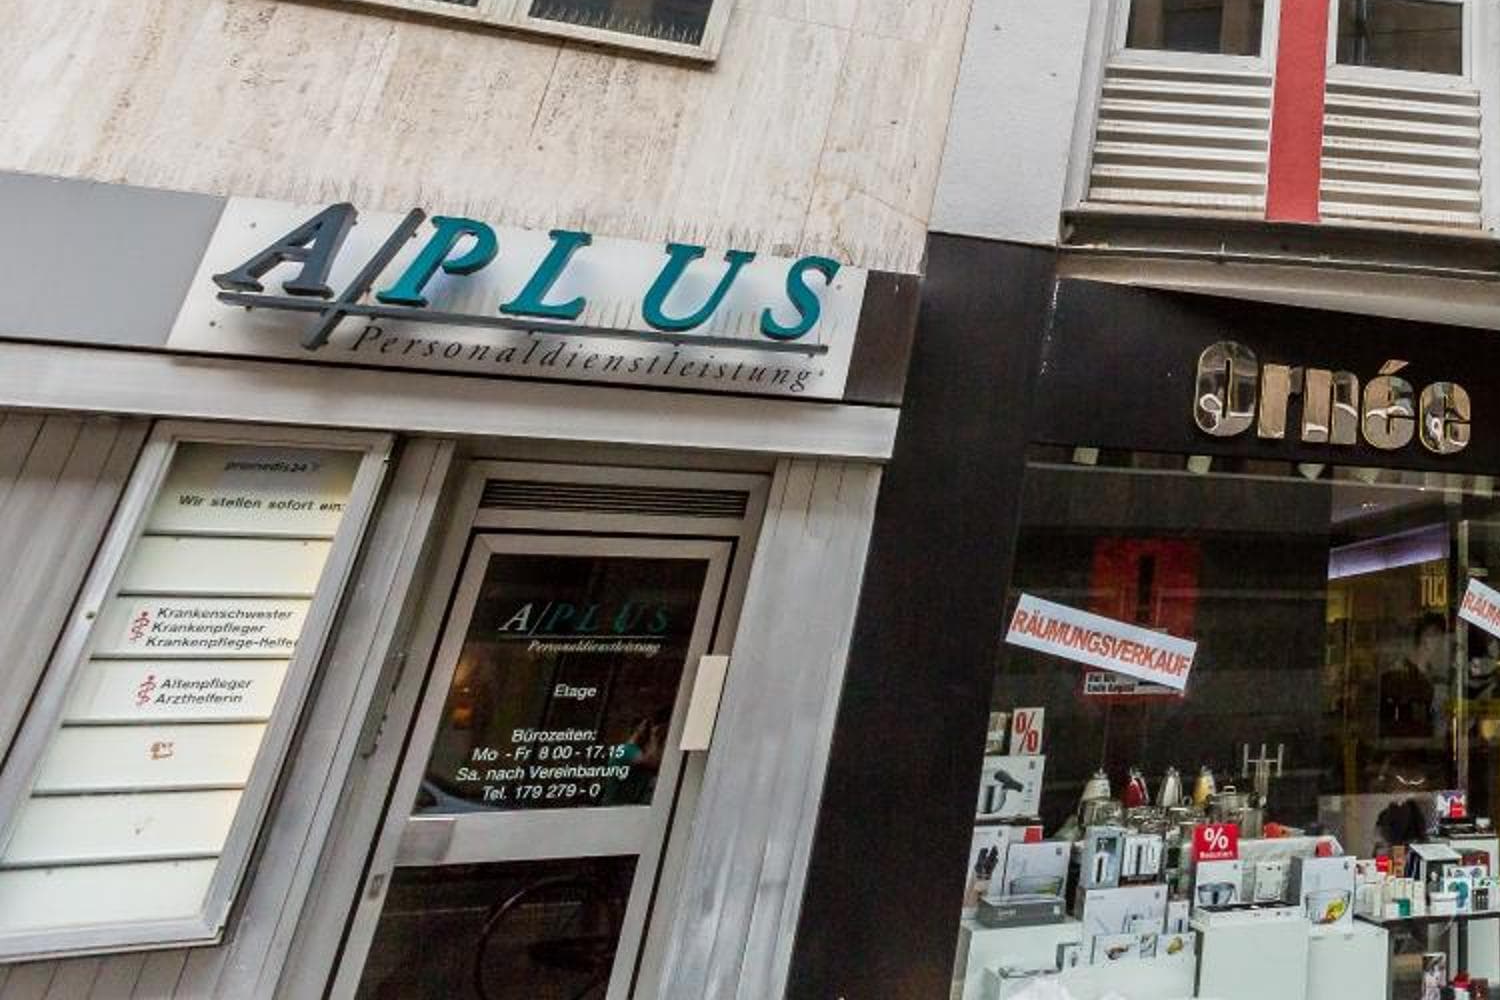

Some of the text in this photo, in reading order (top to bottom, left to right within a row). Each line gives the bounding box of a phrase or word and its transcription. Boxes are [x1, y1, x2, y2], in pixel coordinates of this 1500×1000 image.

[351, 324, 815, 393] Personaldienstleistung
[1193, 340, 1472, 455] Ornée
[178, 495, 204, 507] Wir
[209, 496, 262, 510] stellen
[267, 499, 314, 512] sofort
[157, 607, 295, 621] Krankenschwester
[151, 621, 266, 636] Krankenpfleger
[1011, 608, 1192, 678] RÄUMUNGSVERKAUF
[161, 679, 253, 691] Altenpfleger
[553, 684, 597, 699] Etage
[154, 693, 244, 706] Arzthelferin
[511, 728, 599, 743] Bürozeiten:
[1012, 711, 1040, 754] %
[471, 748, 498, 762] Mo
[513, 747, 533, 761] Fr
[586, 744, 626, 759] 17.15
[455, 763, 631, 782] Sa. nach Vereinbarung
[482, 784, 508, 801] Tel.
[515, 785, 543, 800] 179
[546, 783, 577, 798] 279
[589, 783, 602, 797] 0
